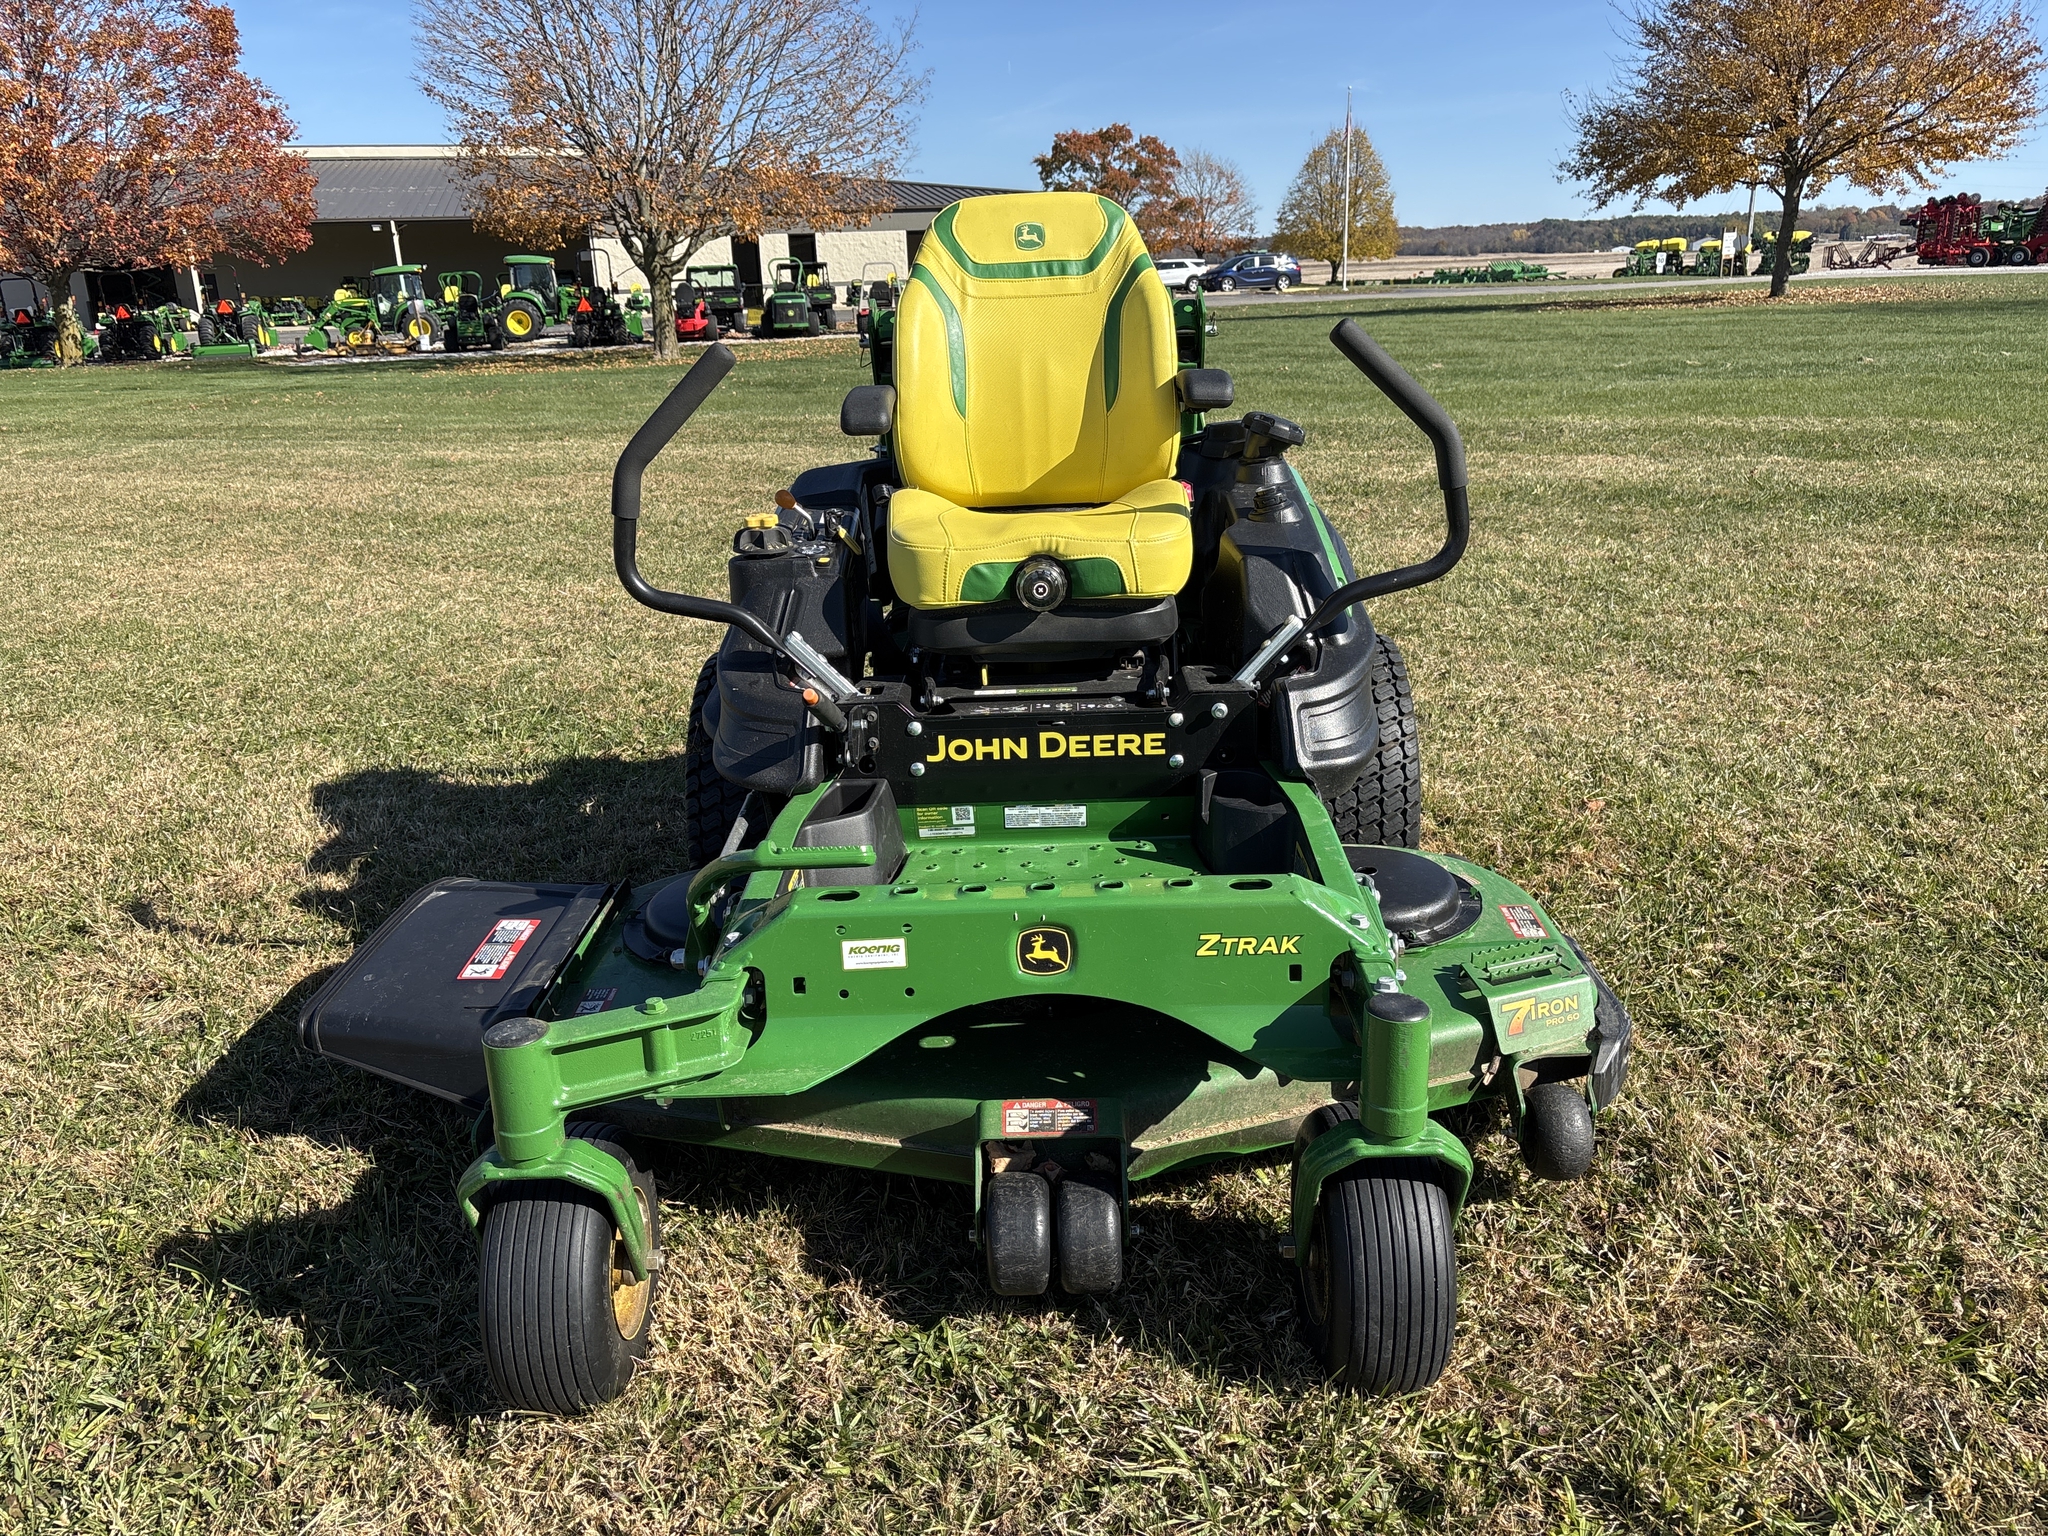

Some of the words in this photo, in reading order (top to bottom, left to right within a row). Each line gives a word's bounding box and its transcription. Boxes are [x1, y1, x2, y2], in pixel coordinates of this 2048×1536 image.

[926, 735, 1028, 762] JOHN
[1039, 731, 1166, 758] DEERE
[1195, 933, 1303, 957] ZTRAK
[1501, 996, 1536, 1036] 7
[1530, 994, 1579, 1021] IRON
[1545, 1016, 1565, 1027] PRO
[1566, 1012, 1580, 1022] 60
[1022, 1101, 1047, 1109] DANGER
